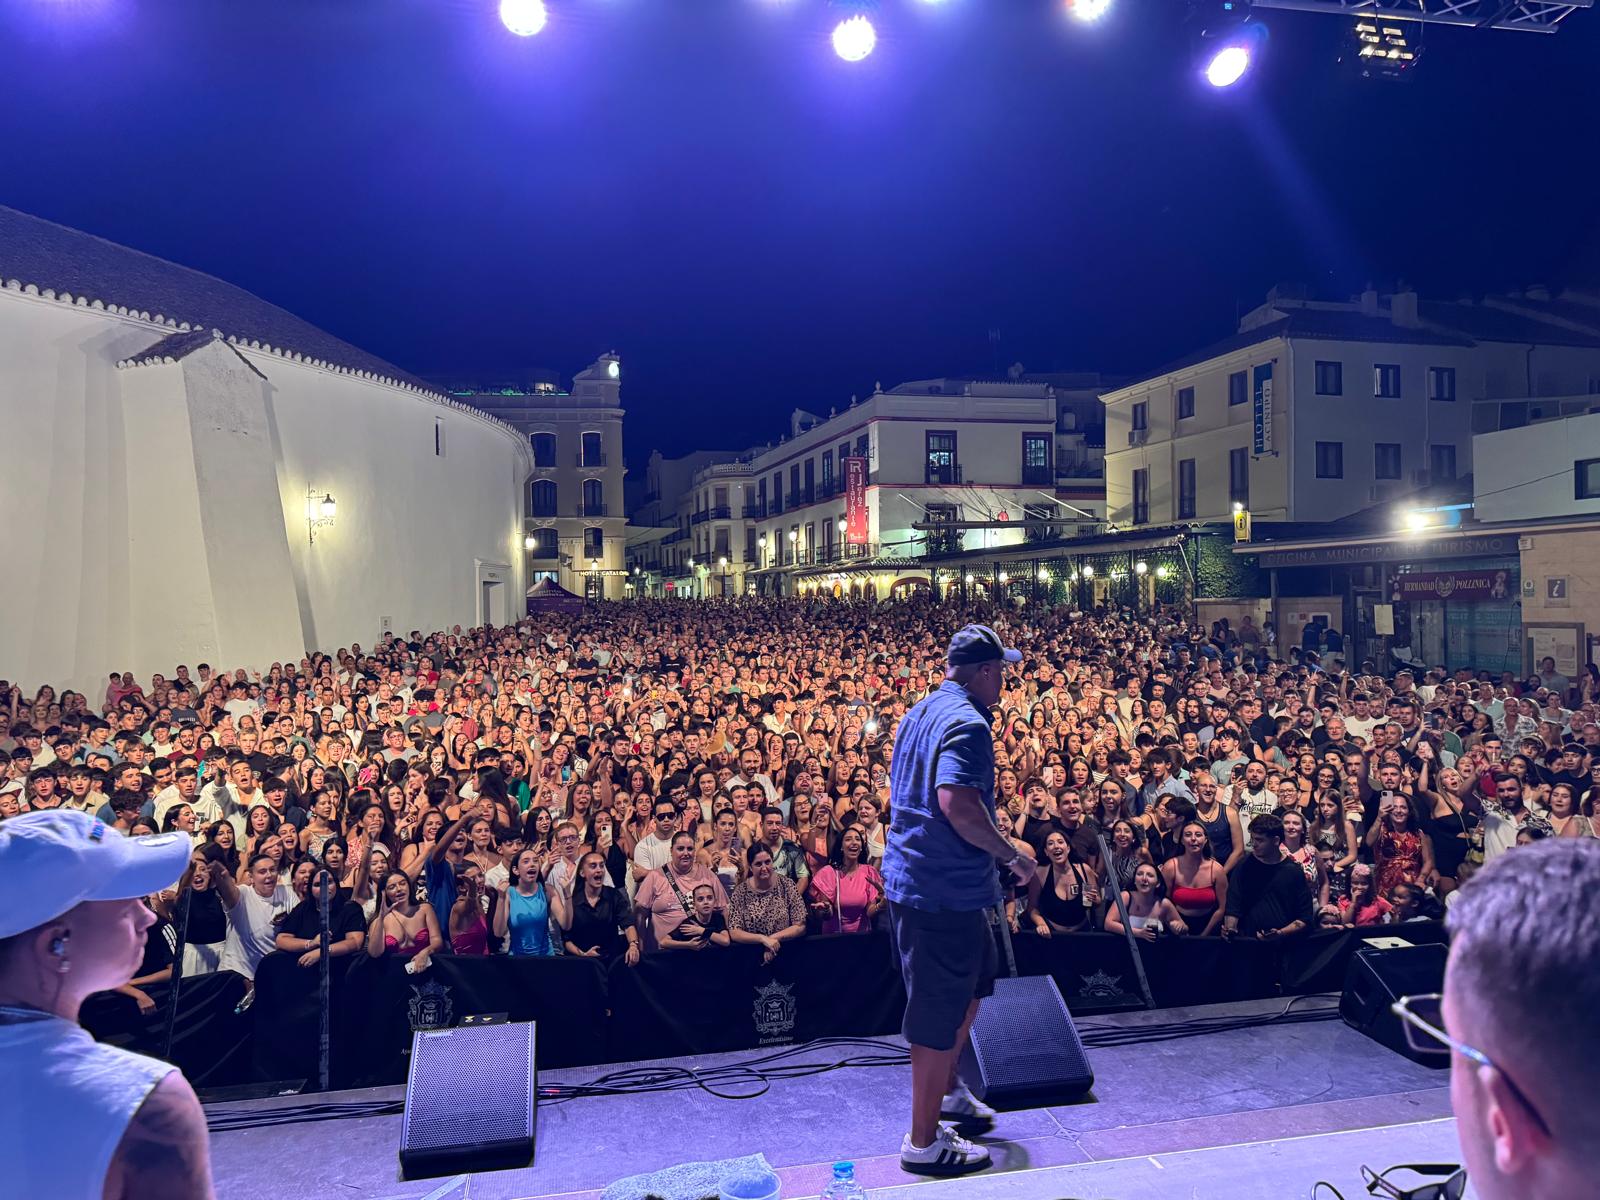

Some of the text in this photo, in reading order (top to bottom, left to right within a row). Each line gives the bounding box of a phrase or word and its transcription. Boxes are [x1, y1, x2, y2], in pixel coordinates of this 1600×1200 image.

[1255, 385, 1263, 448] HOTEL
[1267, 551, 1317, 564] OFICINA
[1326, 545, 1398, 560] MUNICIPAL
[1432, 539, 1504, 554] TURISMO
